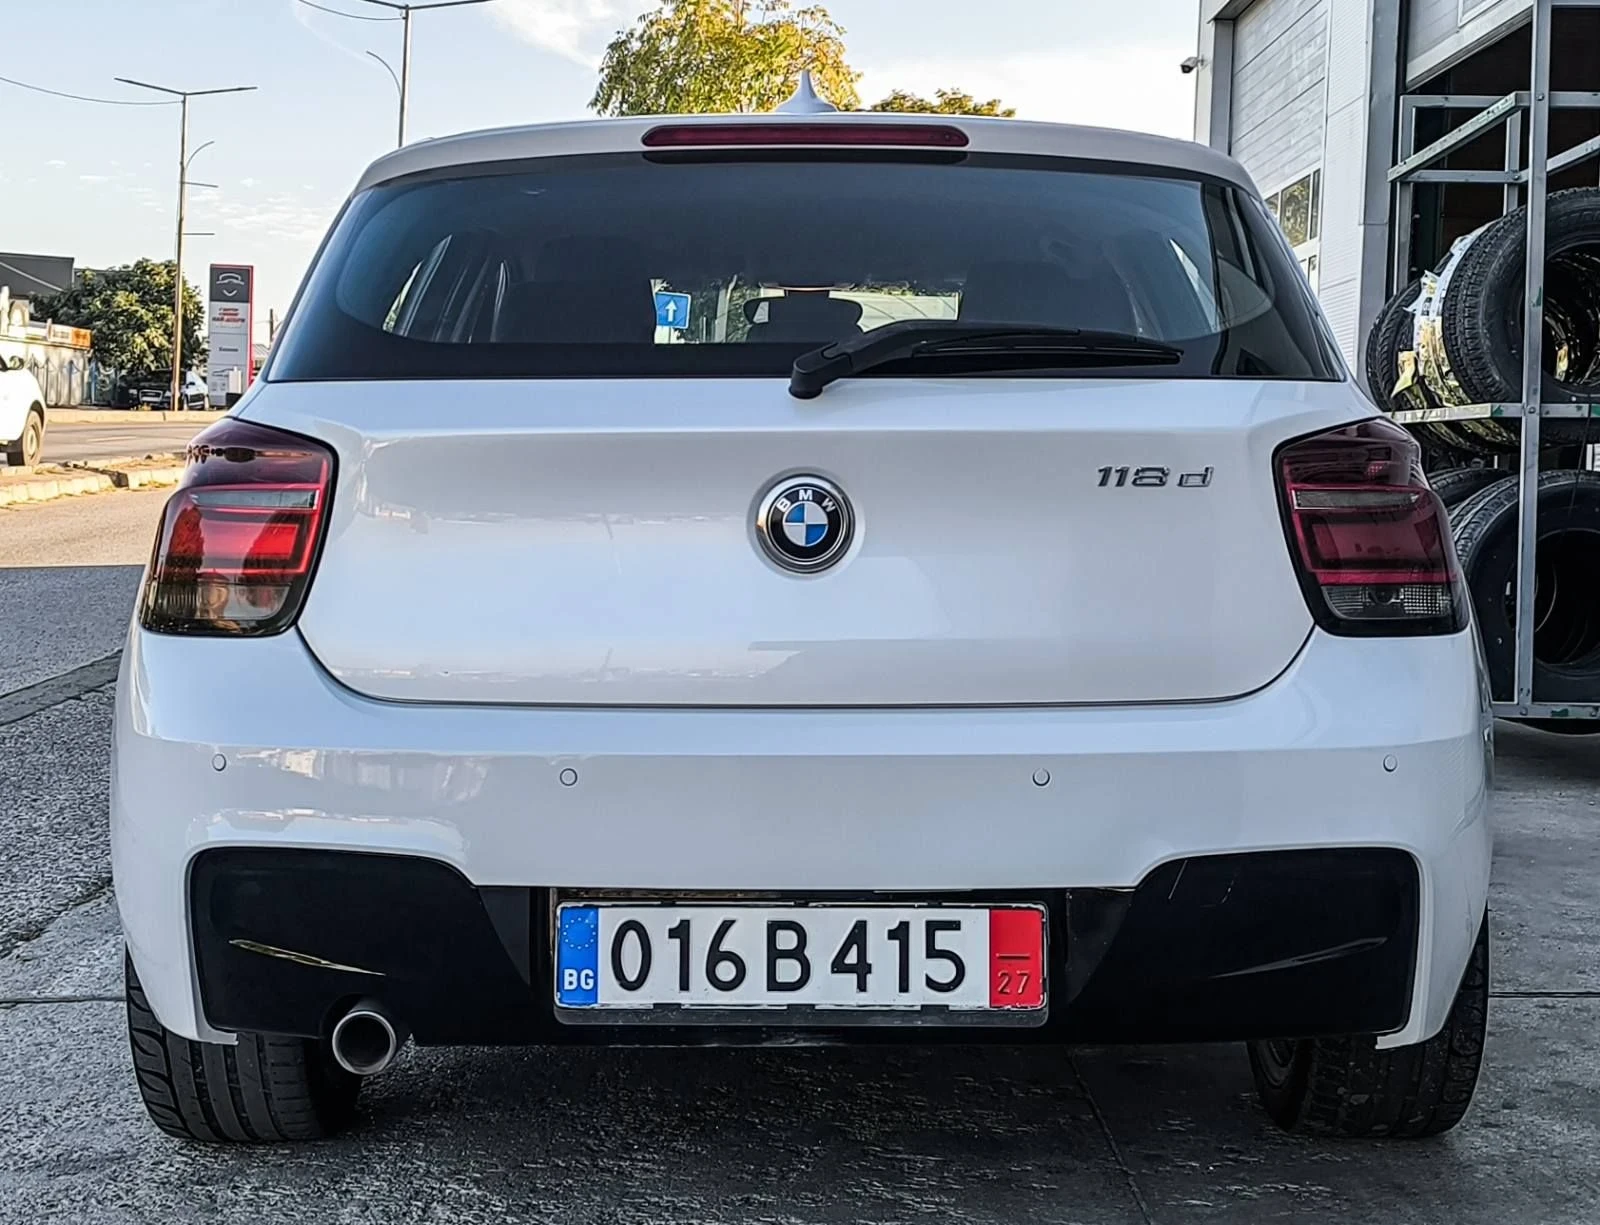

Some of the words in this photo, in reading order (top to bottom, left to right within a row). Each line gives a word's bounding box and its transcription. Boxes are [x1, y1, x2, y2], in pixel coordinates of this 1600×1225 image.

[775, 489, 836, 513] BMW
[563, 968, 595, 991] BG
[998, 969, 1030, 994] 27
